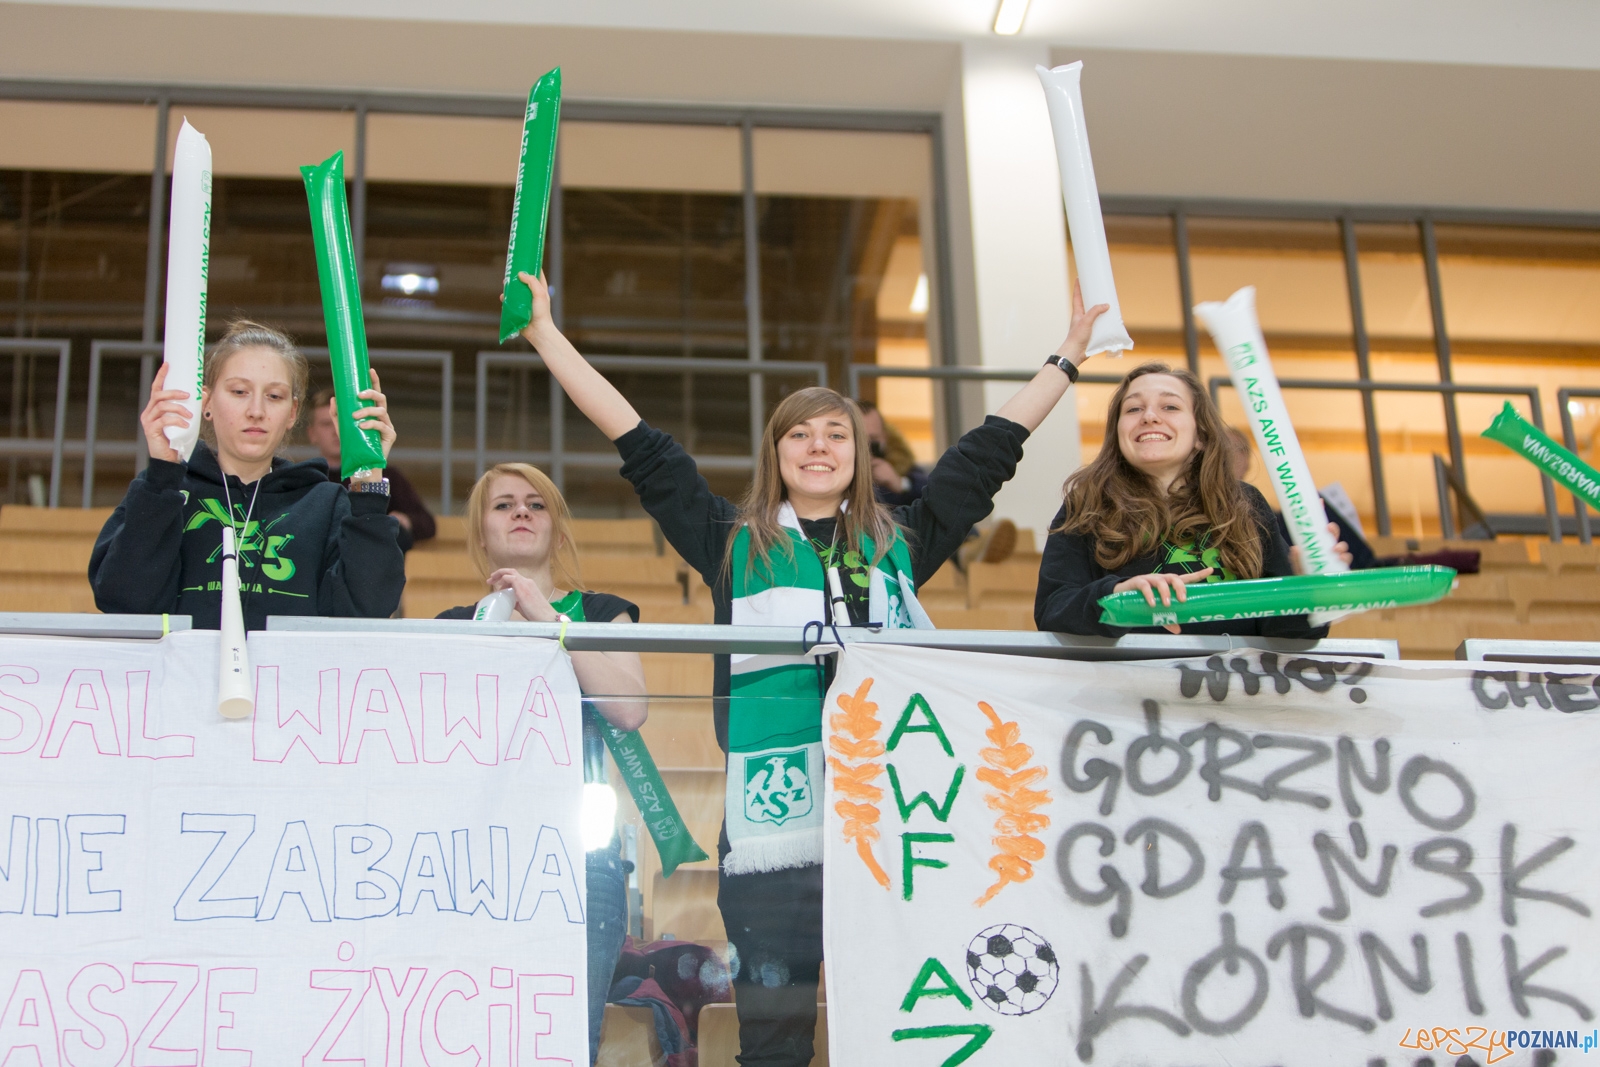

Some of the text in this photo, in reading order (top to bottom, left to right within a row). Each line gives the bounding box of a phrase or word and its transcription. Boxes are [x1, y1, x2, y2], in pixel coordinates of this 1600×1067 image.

[1244, 377, 1328, 573] AZS AWF WARSZAWA
[253, 665, 571, 766] WAWA
[1177, 652, 1600, 714] WHO? CHE
[619, 746, 664, 812] AZS AWF
[174, 812, 585, 923] ZABAWA
